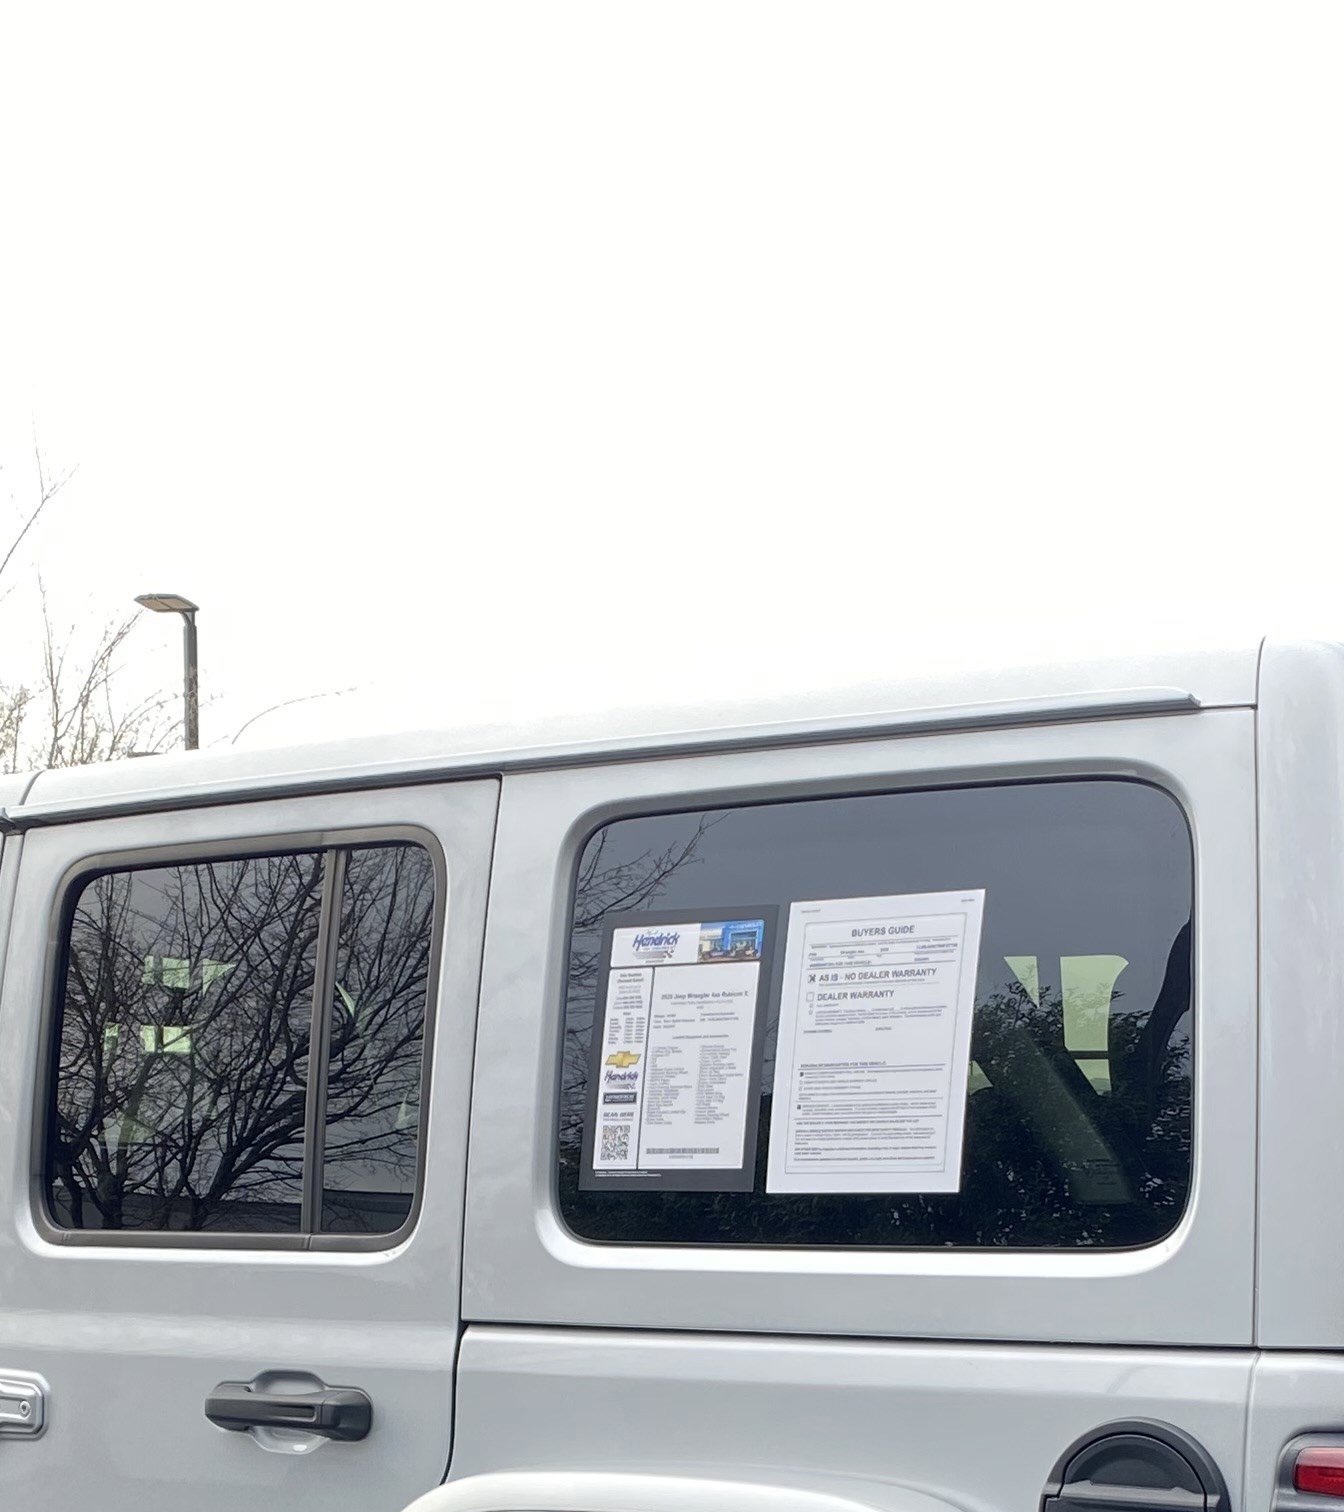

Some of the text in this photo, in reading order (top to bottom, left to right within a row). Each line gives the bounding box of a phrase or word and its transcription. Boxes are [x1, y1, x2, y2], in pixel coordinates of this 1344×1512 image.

[851, 925, 915, 937] BUYERS GUIDE
[632, 932, 681, 951] Hendrick
[818, 973, 829, 982] AS
[830, 973, 838, 981] IS
[844, 972, 857, 981] NO
[858, 970, 889, 980] DEALER
[891, 968, 937, 978] WARRANTY
[817, 990, 894, 1001] DEALER WARRANTY
